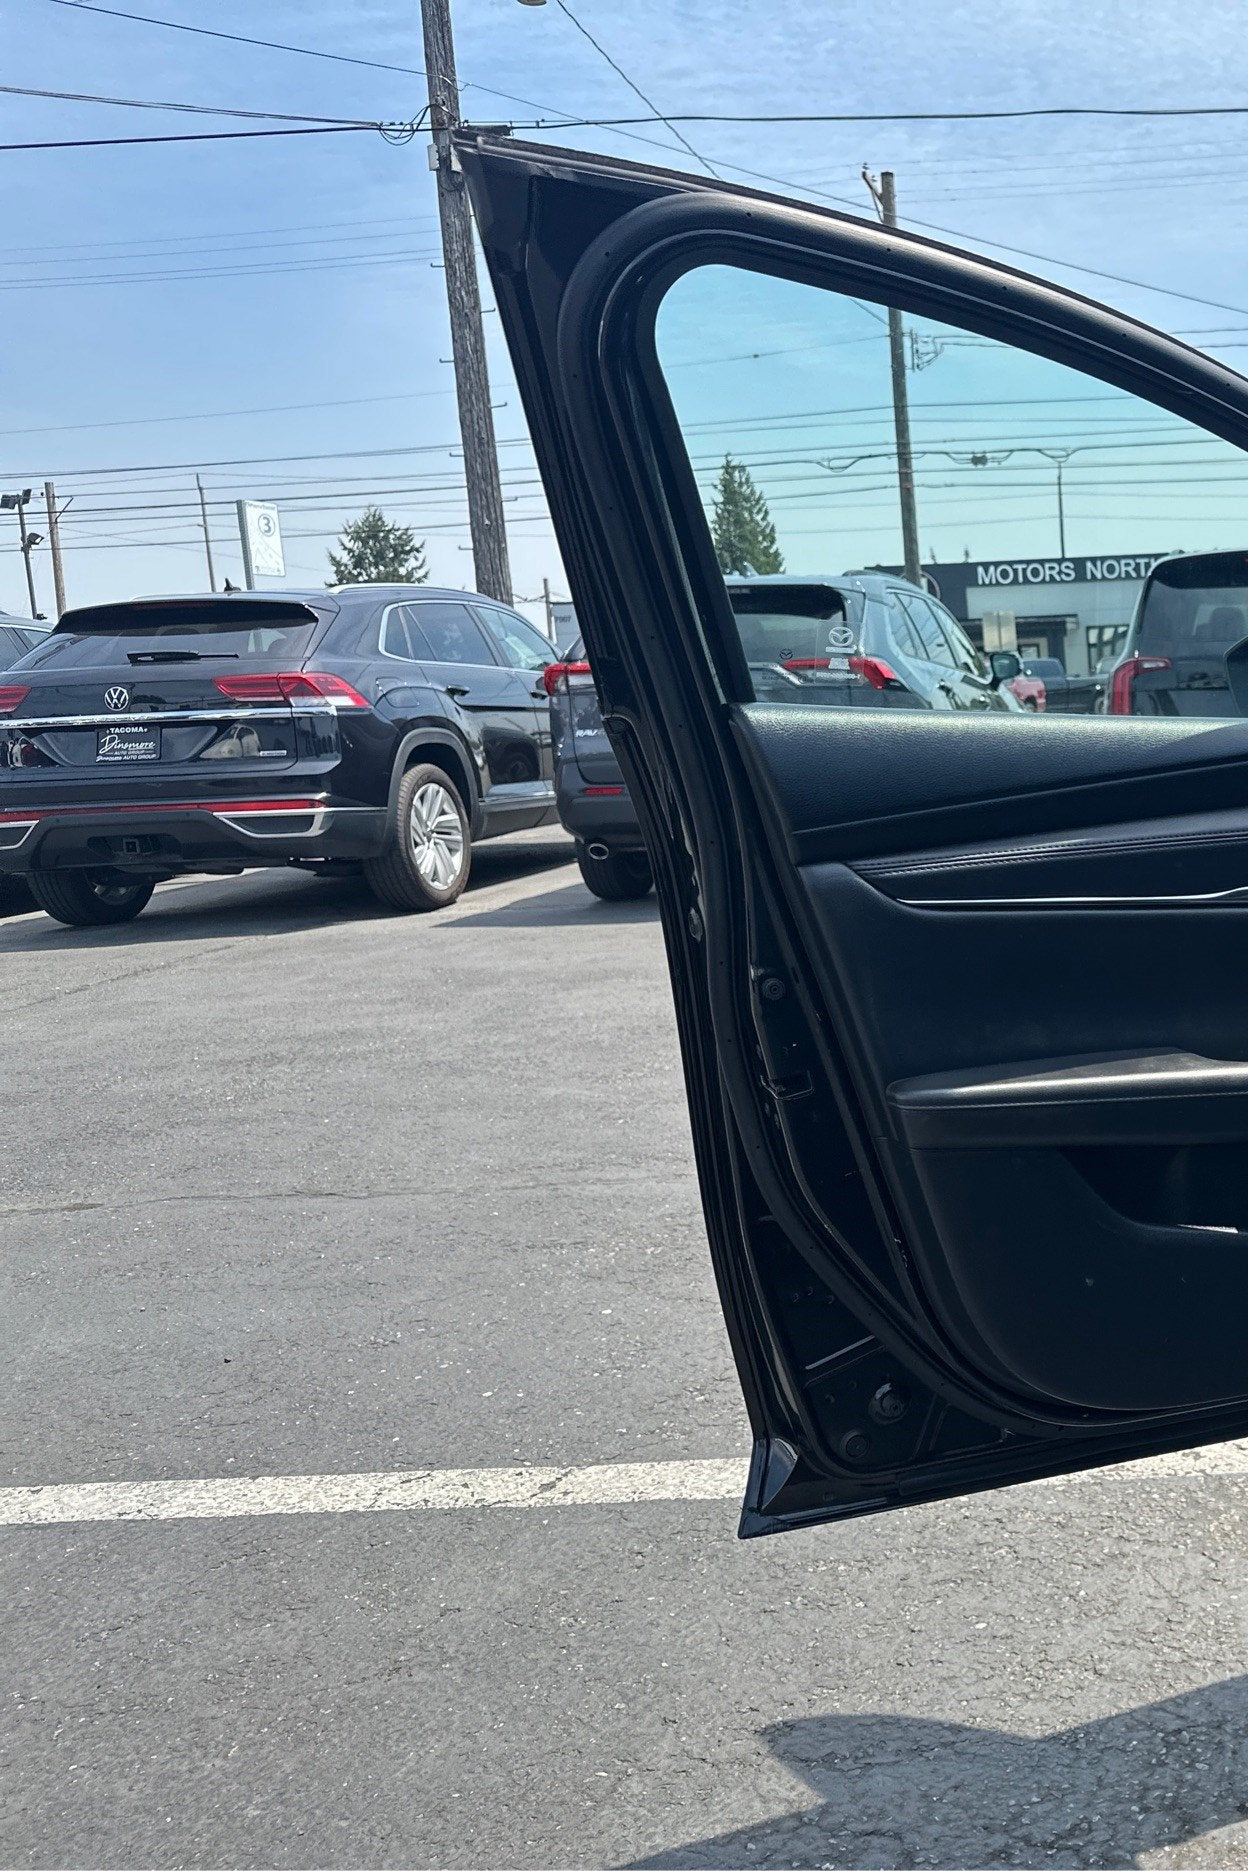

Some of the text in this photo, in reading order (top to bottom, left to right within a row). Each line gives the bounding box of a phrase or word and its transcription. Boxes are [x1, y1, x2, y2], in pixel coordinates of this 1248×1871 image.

[262, 516, 272, 534] 3
[977, 557, 1156, 585] MOTORS NORT
[110, 726, 144, 734] TACOMA
